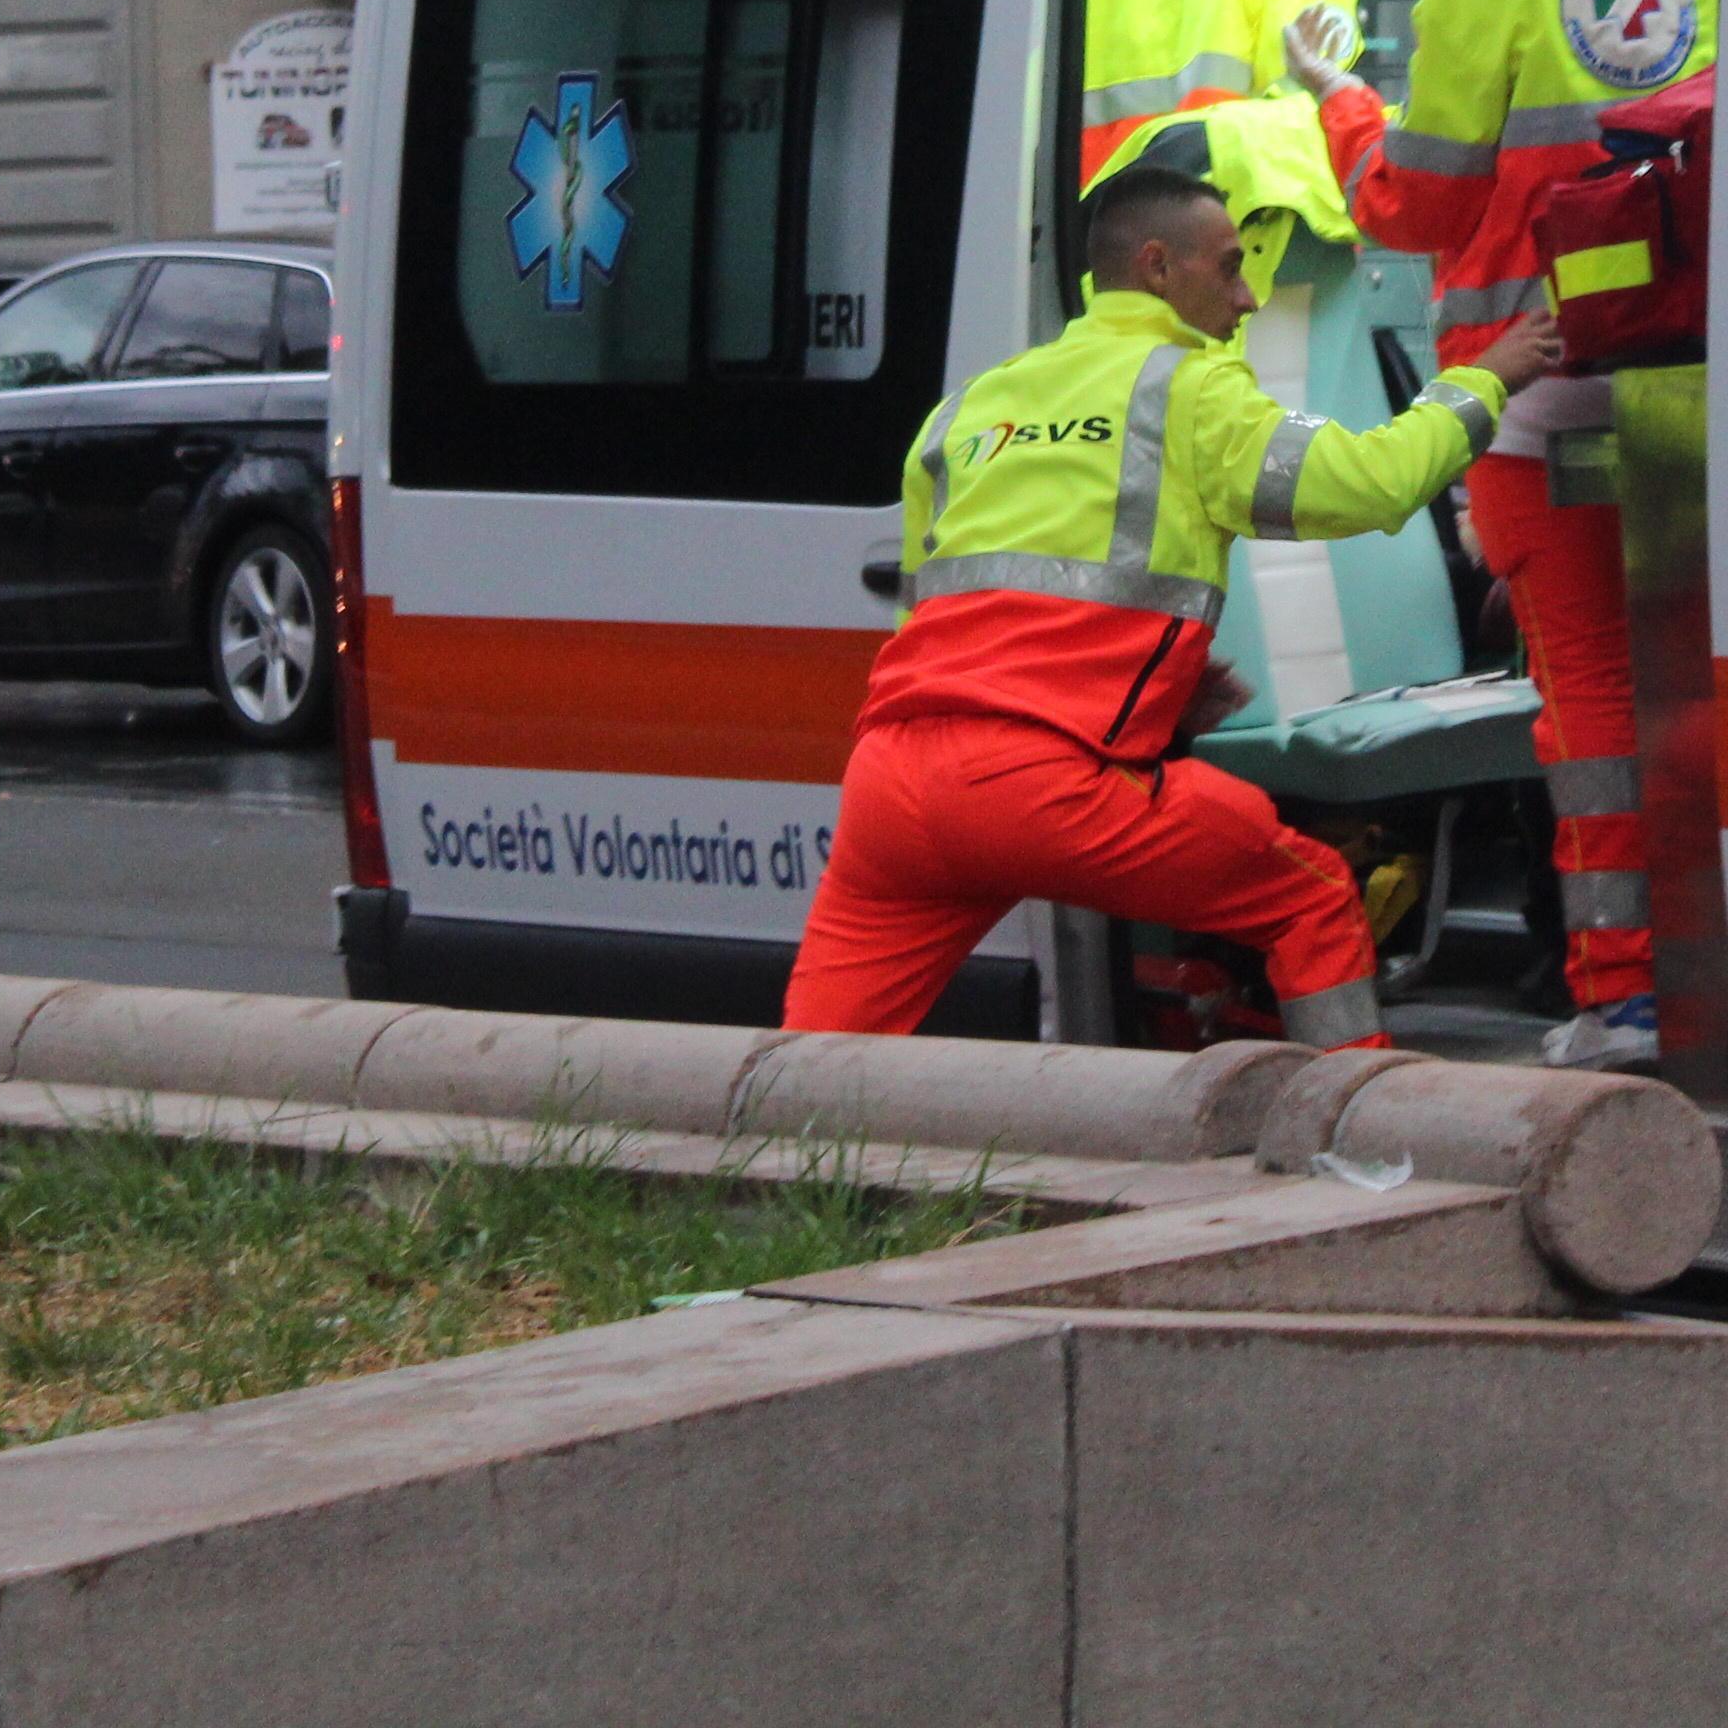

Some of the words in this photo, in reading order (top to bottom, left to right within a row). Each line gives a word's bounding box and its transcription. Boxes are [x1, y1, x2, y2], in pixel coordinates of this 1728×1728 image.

[1010, 416, 1113, 445] SVS
[421, 801, 556, 875] Società
[563, 813, 759, 888] Volontaria
[771, 823, 807, 891] di
